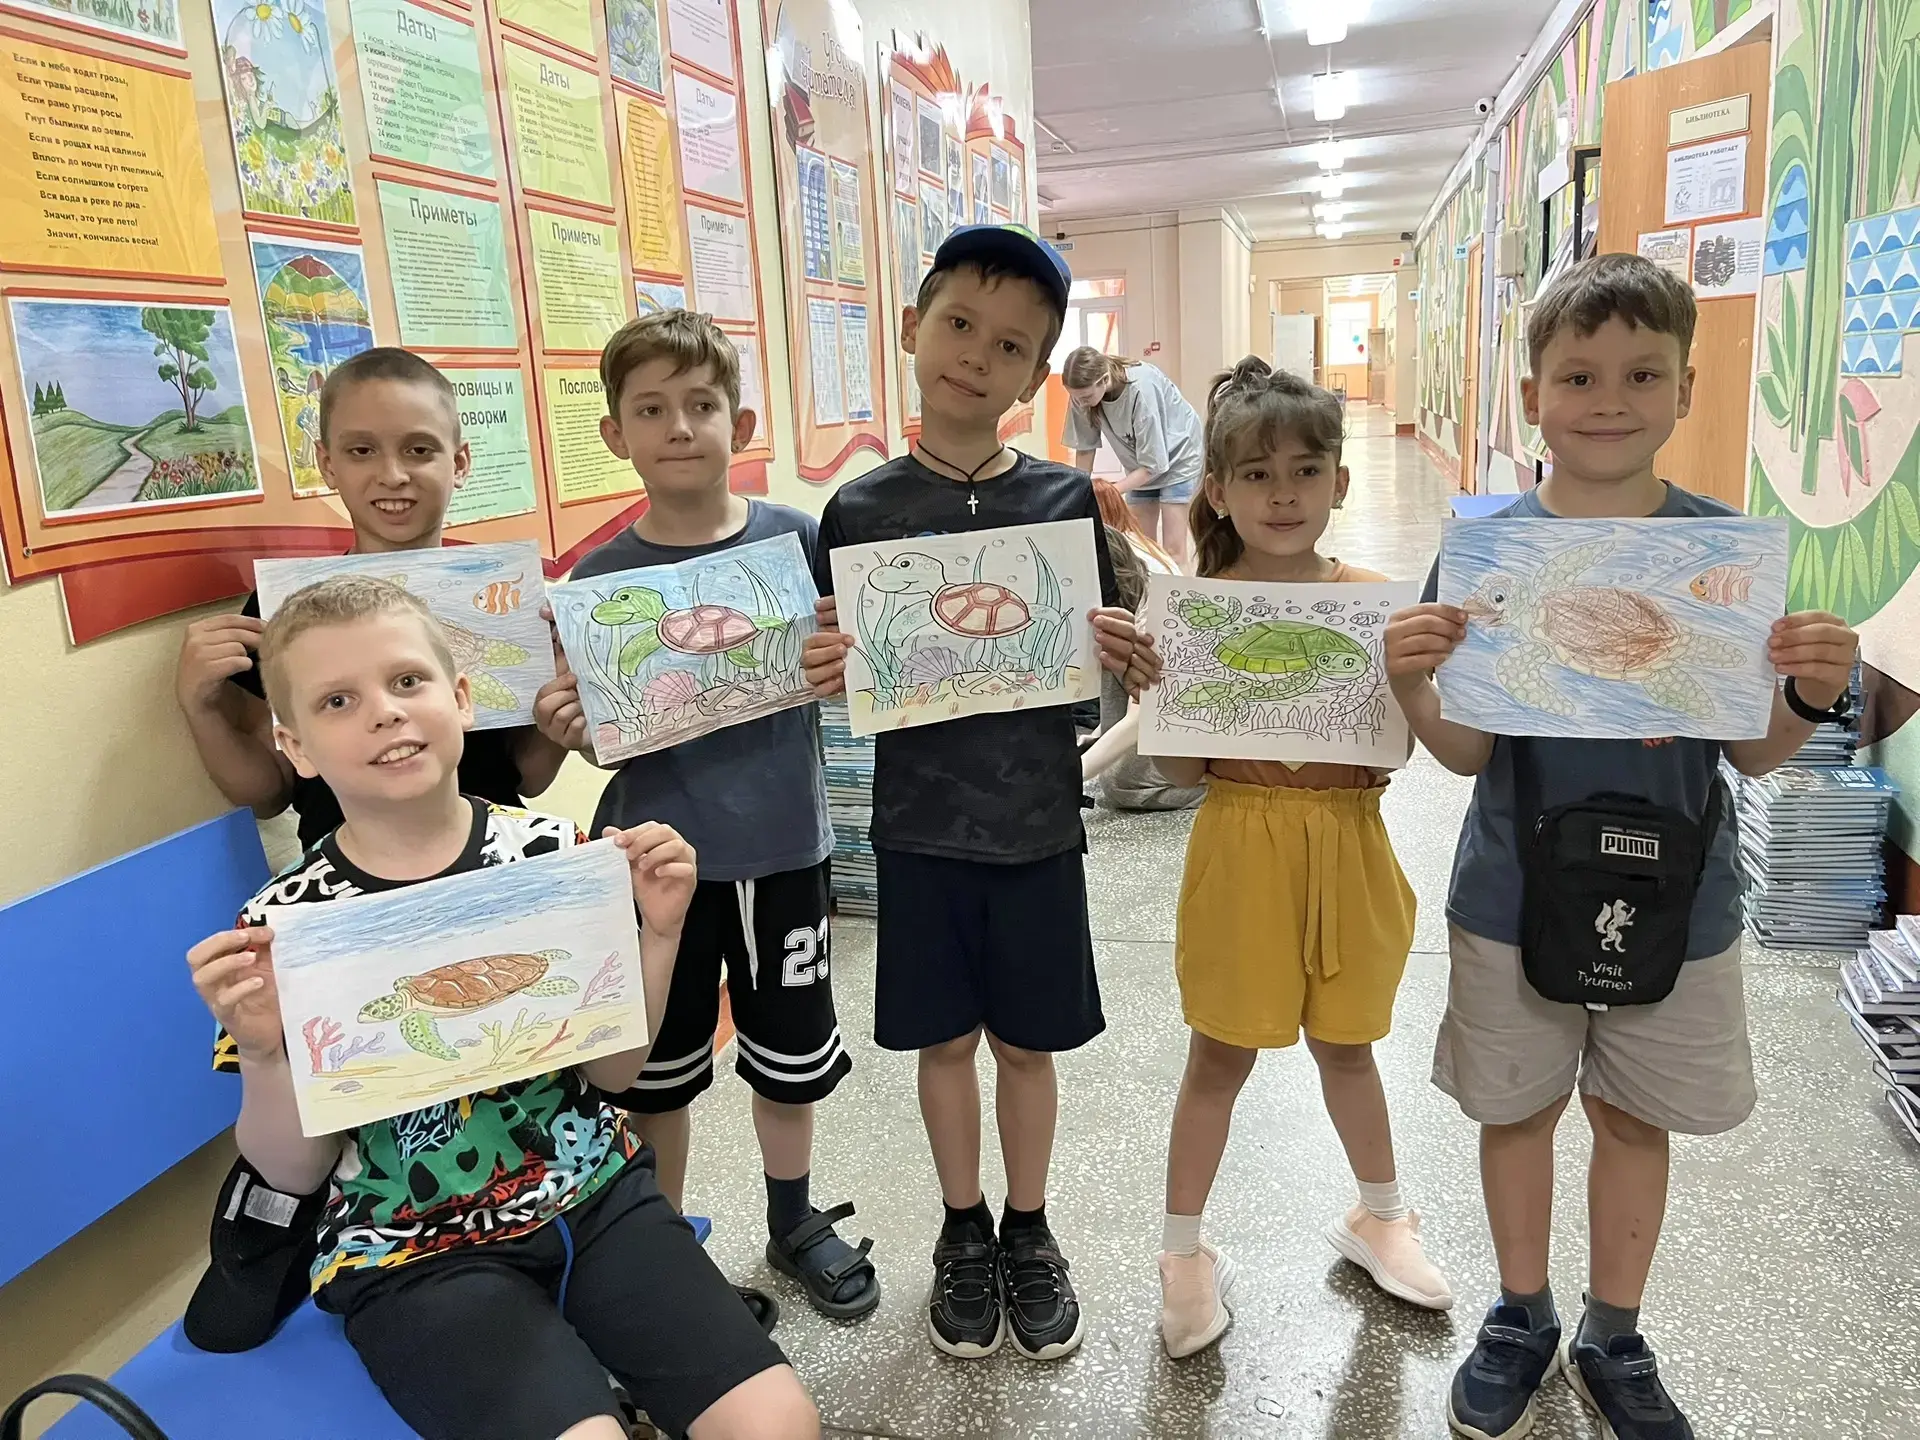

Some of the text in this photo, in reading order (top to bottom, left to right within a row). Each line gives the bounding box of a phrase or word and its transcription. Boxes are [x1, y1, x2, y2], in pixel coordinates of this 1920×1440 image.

[397, 9, 437, 42] Даты
[12, 52, 37, 64] Если
[48, 61, 71, 72] небе
[73, 67, 97, 79] ходят
[100, 73, 129, 86] грозы,
[539, 62, 570, 90] Даты
[17, 72, 118, 102] Если травы расцвели,
[21, 92, 122, 119] Если рано утром росы
[696, 88, 716, 108] Даты
[25, 112, 134, 139] Гнут былинки до земли,
[1685, 108, 1731, 124] БИБЛИОТЕКА
[29, 132, 52, 144] Если
[63, 139, 92, 150] рощах
[94, 143, 110, 154] над
[112, 147, 147, 158] калиной
[1673, 145, 1739, 163] БИБЛИОТЕКА РАБОТАЕТ
[32, 152, 165, 179] Вплоть до ночи гул пчелиный,
[36, 171, 149, 193] Если солнышком согрета
[40, 190, 57, 200] Вся
[59, 195, 81, 203] вода
[90, 197, 111, 206] реке
[113, 200, 123, 208] до
[125, 201, 140, 209] дна
[43, 209, 138, 227] Значит, это уже лето!
[410, 197, 478, 226] Приметы
[551, 221, 601, 247] Приметы
[701, 215, 734, 235] Приметы
[46, 228, 159, 246] Значит, кончилась весна!
[451, 381, 514, 399] ловицы и
[559, 378, 603, 395] Послов
[458, 410, 507, 429] оворки
[1603, 834, 1657, 859] PUMA
[1592, 961, 1623, 977] Visit
[1577, 970, 1633, 991] Tyumen
